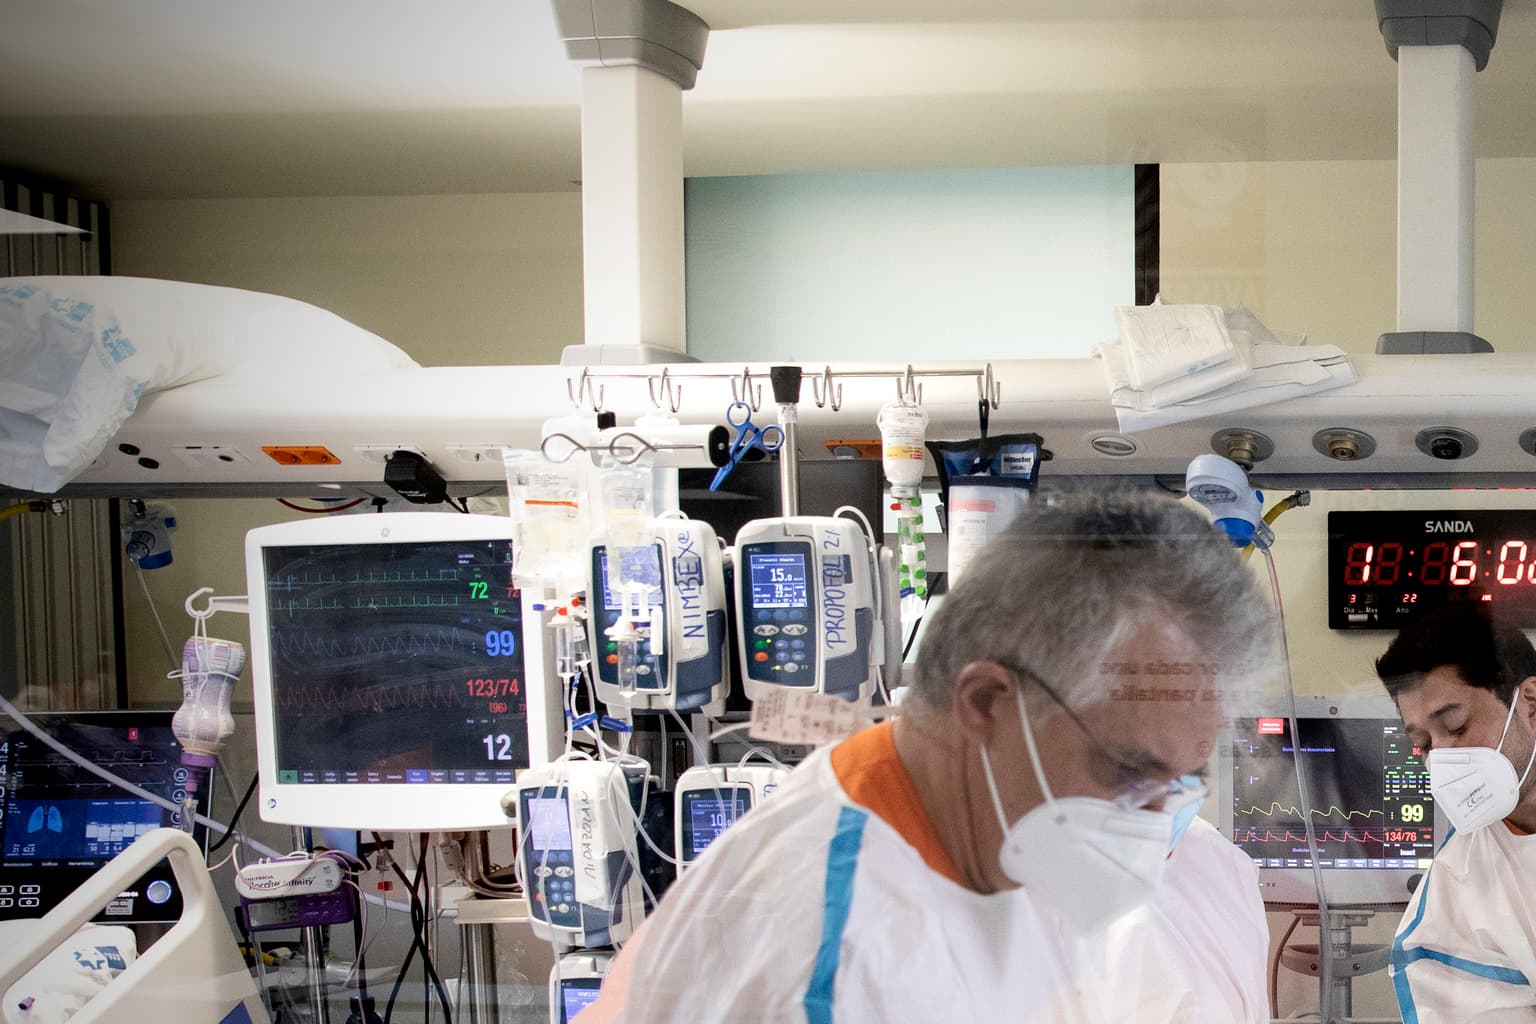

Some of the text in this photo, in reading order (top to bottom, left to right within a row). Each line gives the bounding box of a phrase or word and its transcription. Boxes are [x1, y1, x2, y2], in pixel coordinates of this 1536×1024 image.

[1424, 520, 1474, 534] SANDA
[468, 581, 489, 599] 72
[822, 562, 848, 650] PROPOFOL
[485, 630, 516, 657] 99
[466, 679, 520, 697] 123/74
[483, 734, 513, 760] 12
[1401, 803, 1424, 822] 99
[1384, 831, 1417, 842] 134/76
